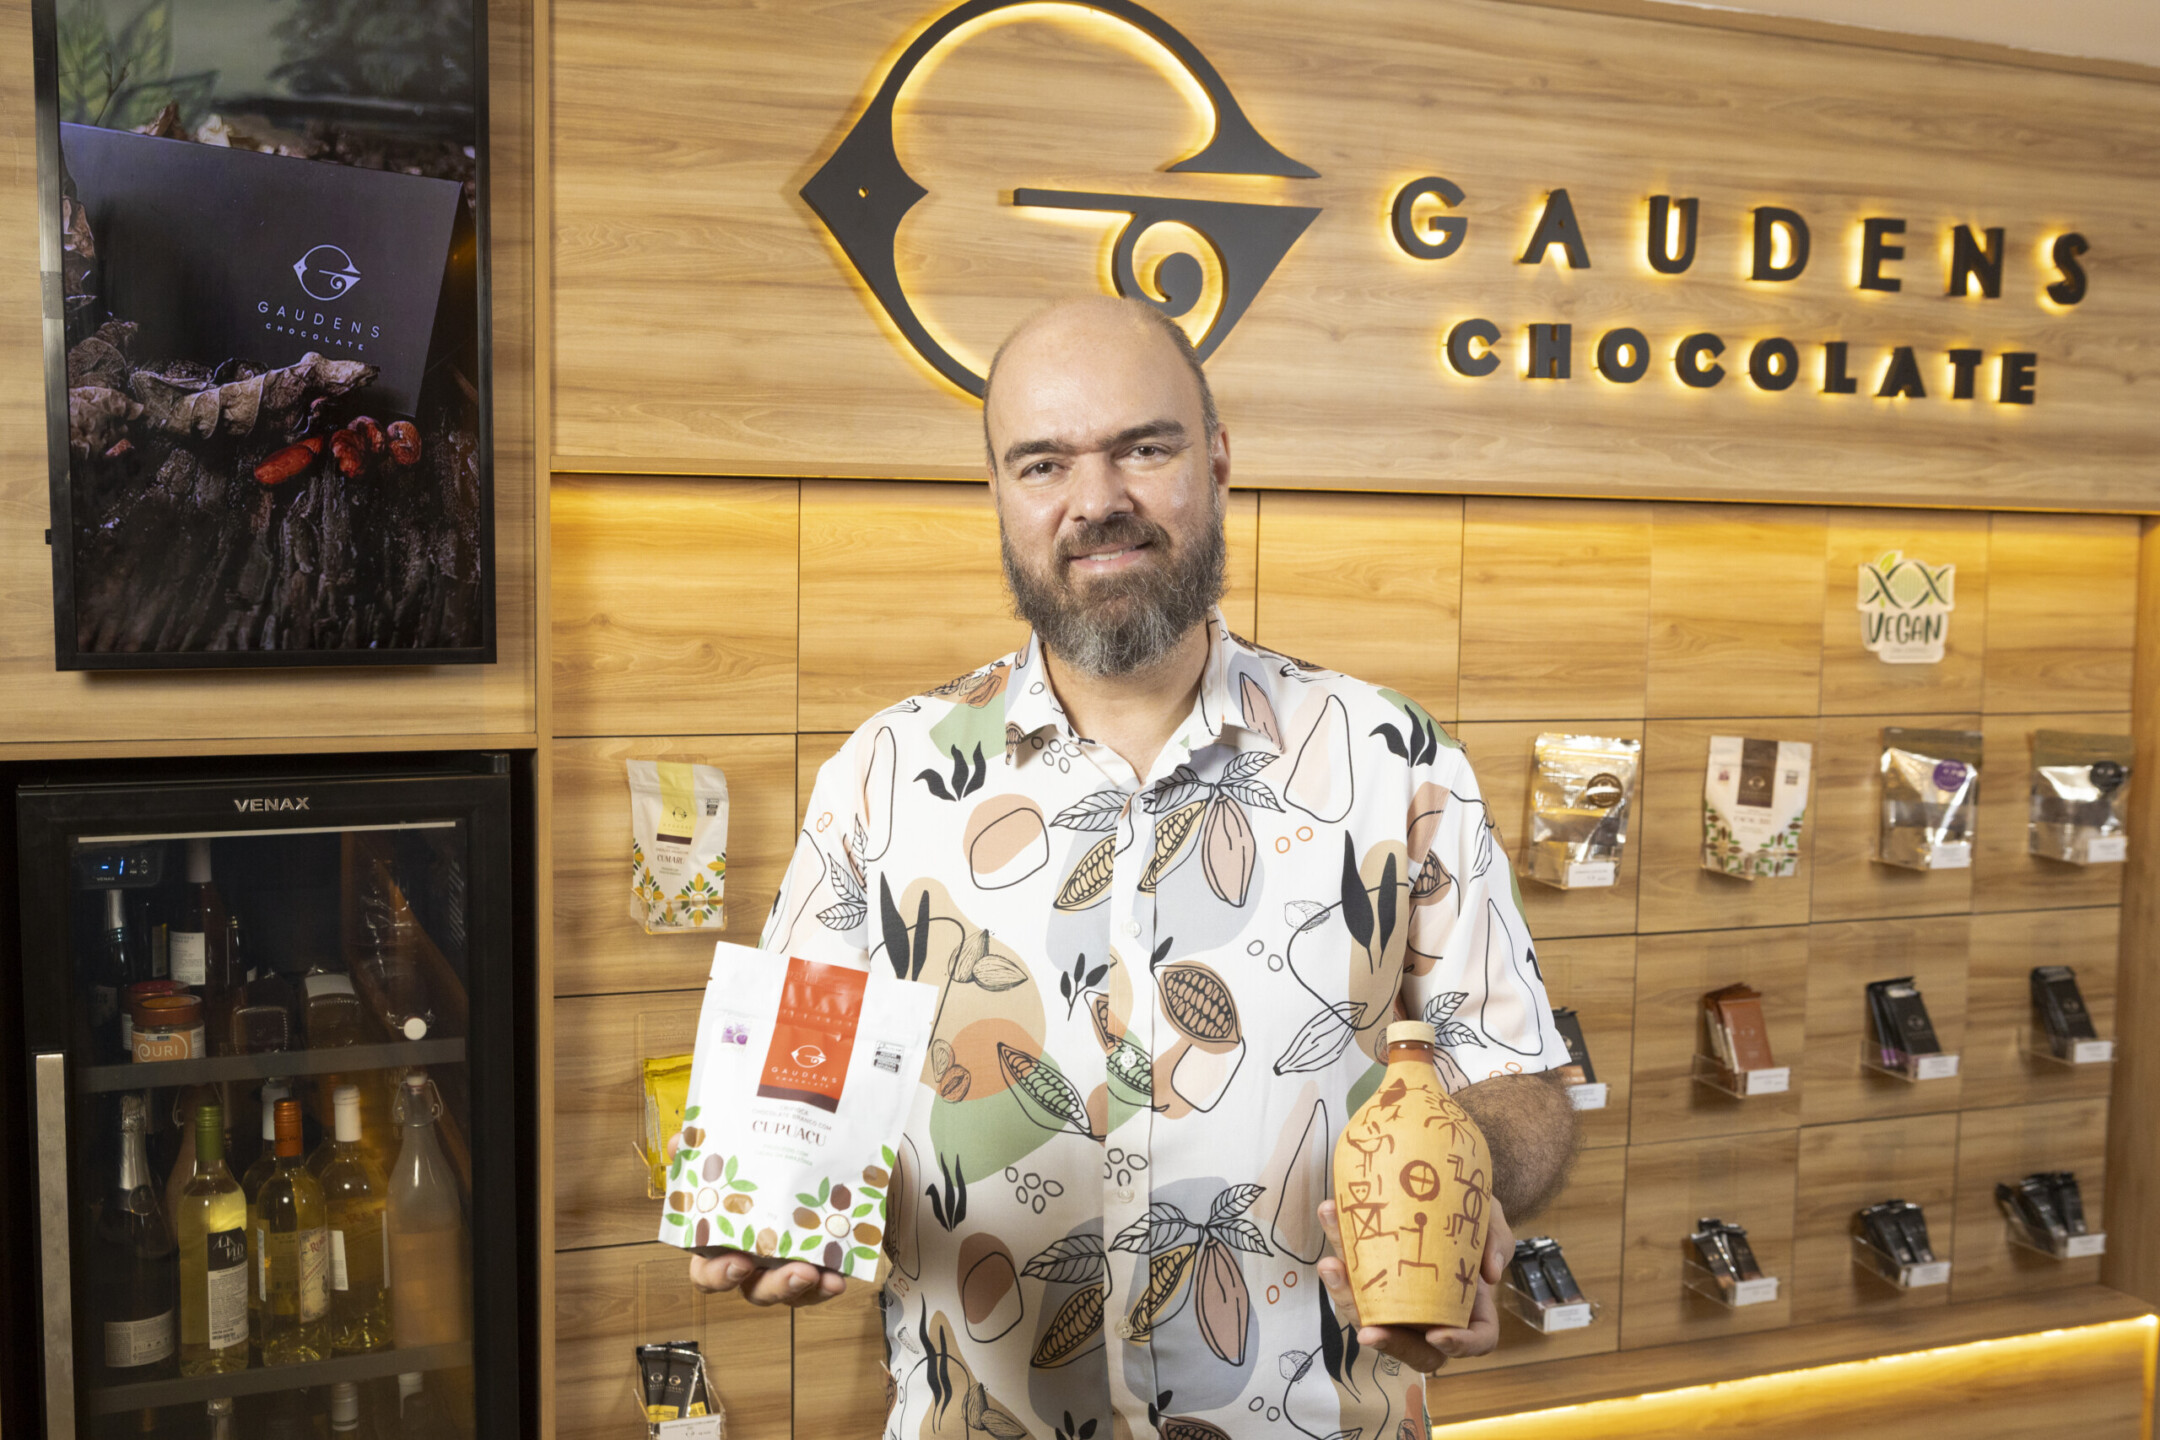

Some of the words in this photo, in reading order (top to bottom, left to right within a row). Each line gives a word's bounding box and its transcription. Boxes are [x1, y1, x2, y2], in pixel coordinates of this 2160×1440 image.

[1390, 176, 2089, 305] GAUDENS
[257, 301, 380, 338] GAUDENS
[265, 322, 364, 351] CHOCOLATE
[1446, 318, 2037, 405] CHOCOLATE
[1867, 611, 1942, 645] VEGAN
[234, 796, 310, 812] VENAX
[771, 1066, 837, 1084] GAUDENS
[752, 1120, 827, 1147] CUPUAÇU
